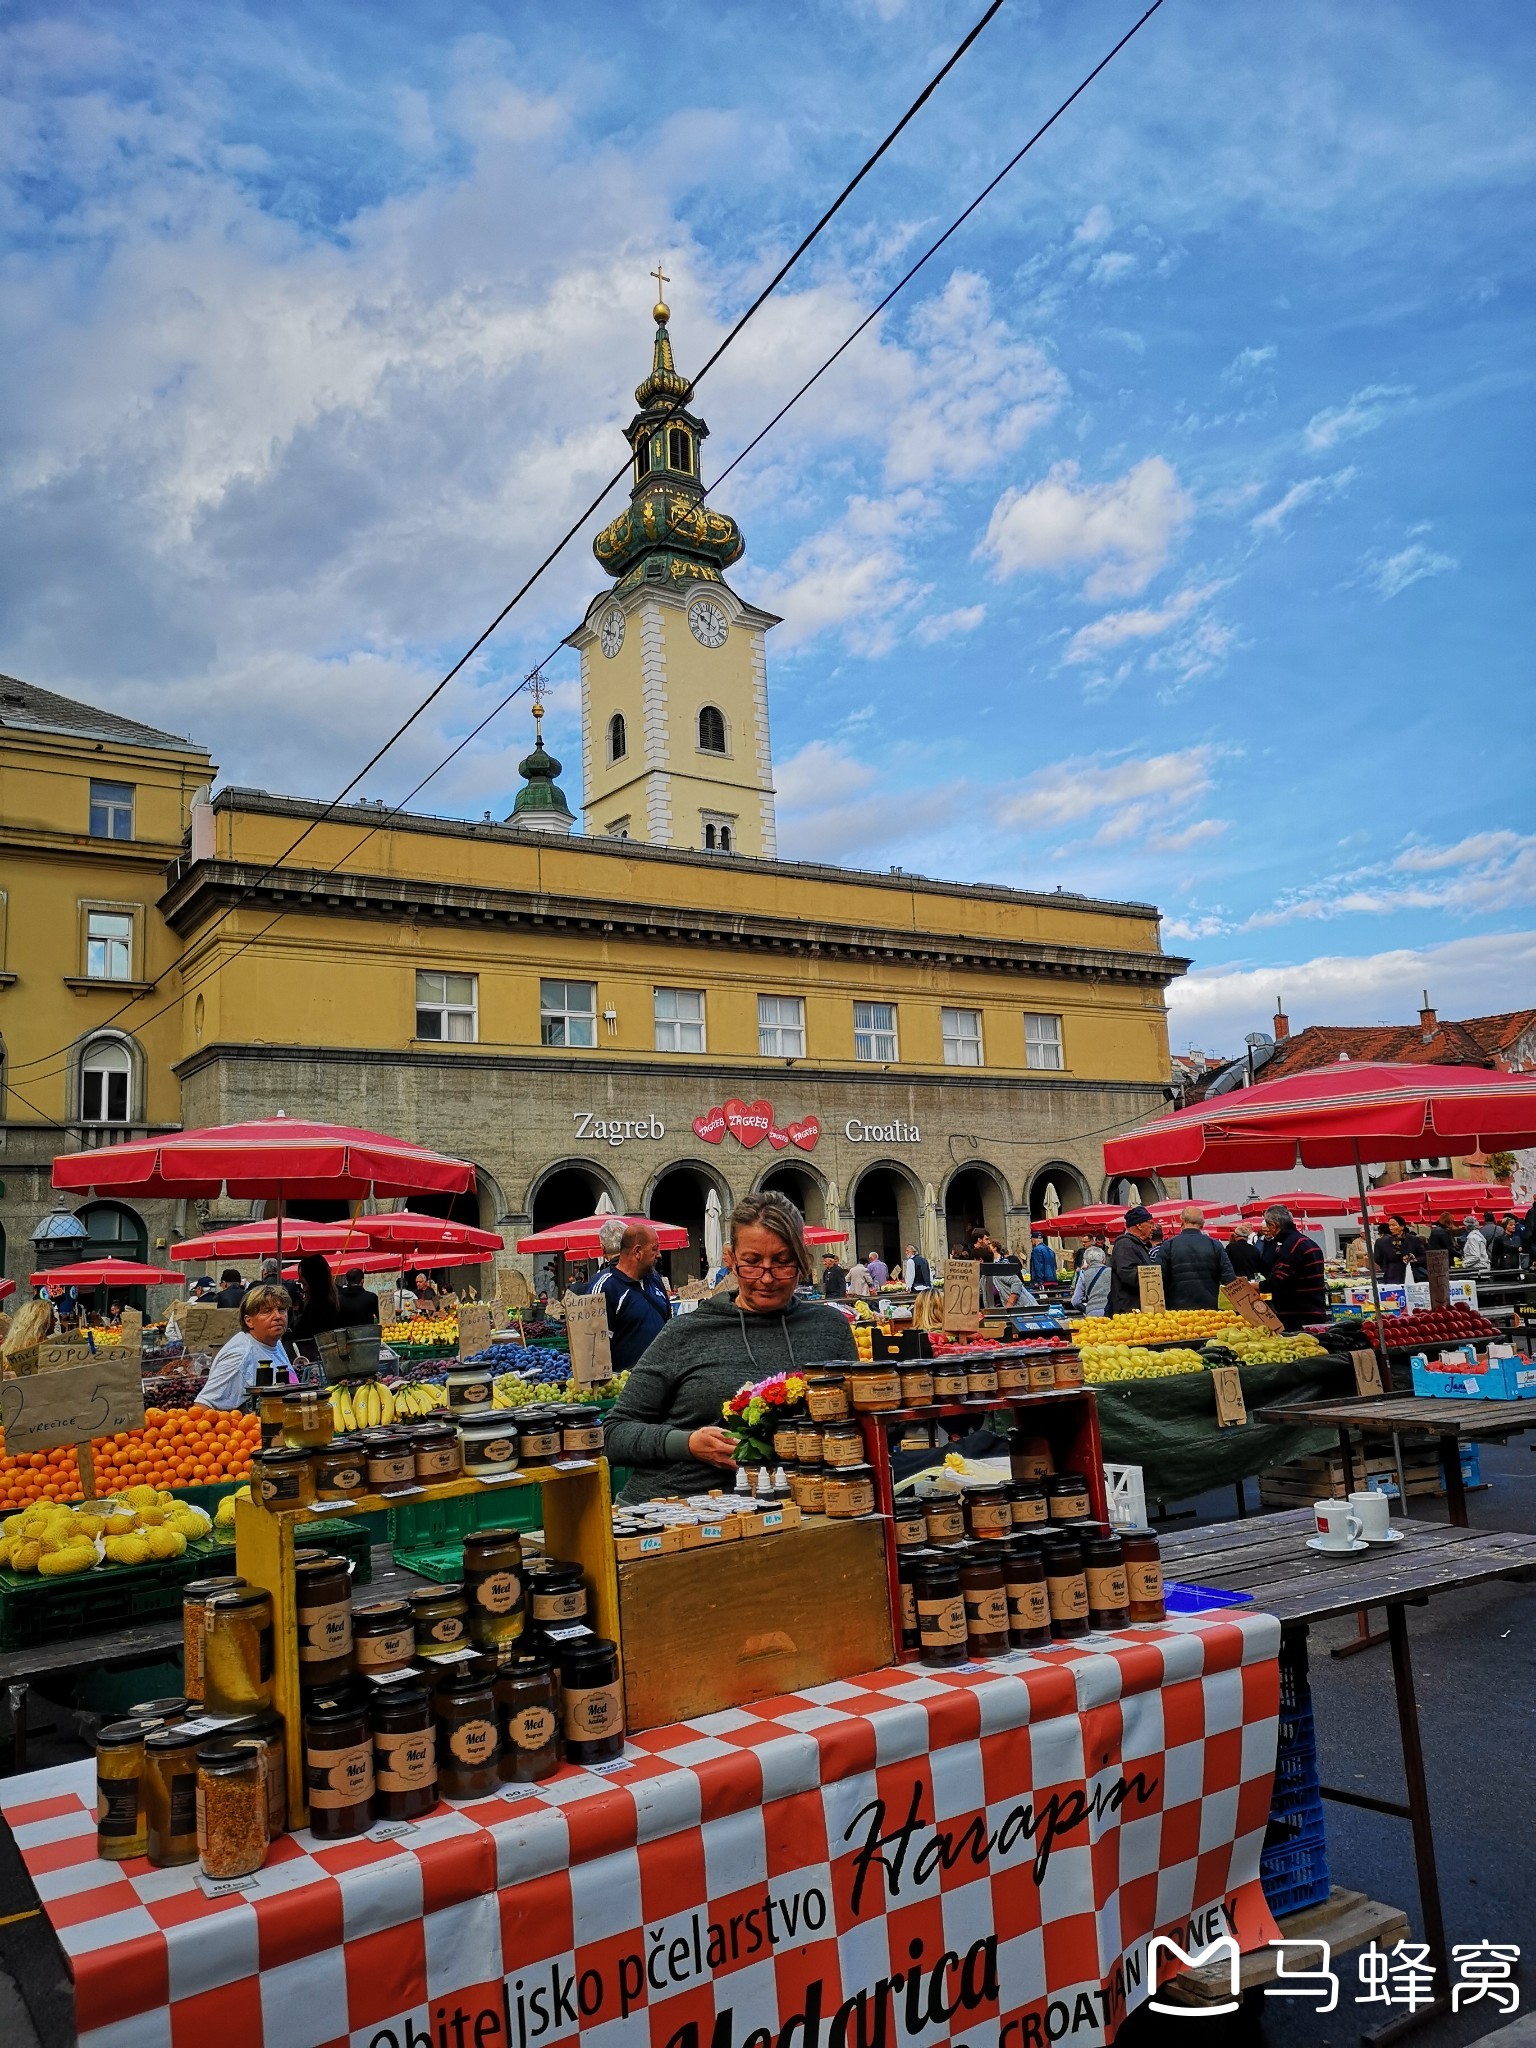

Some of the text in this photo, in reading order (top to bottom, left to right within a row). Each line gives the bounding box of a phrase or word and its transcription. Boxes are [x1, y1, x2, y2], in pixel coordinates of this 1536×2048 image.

[573, 1112, 665, 1146] Zagreb
[698, 1117, 725, 1137] ZAGREB
[728, 1115, 769, 1129] ZAGREB
[845, 1119, 921, 1142] Croatia
[948, 1283, 973, 1316] 20
[1146, 1281, 1160, 1306] 5
[583, 1332, 597, 1368] 7
[1, 1385, 26, 1440] 2
[77, 1383, 110, 1431] 5
[1111, 1580, 1125, 1591] Med
[1143, 1574, 1158, 1584] Med
[491, 1582, 511, 1595] Med
[1073, 1590, 1086, 1600] Med
[991, 1601, 1005, 1612] Med
[1030, 1596, 1044, 1606] Med
[951, 1611, 964, 1622] Med
[325, 1620, 345, 1634] Med
[441, 1622, 457, 1632] Med
[384, 1639, 400, 1651] Med
[587, 1702, 607, 1716] Med
[523, 1717, 544, 1731] Med
[465, 1731, 486, 1745] Med
[406, 1747, 426, 1762] Med
[346, 1761, 366, 1777] Med
[619, 1887, 827, 2020] pčelarstvo
[844, 1753, 1159, 1916] Harapin
